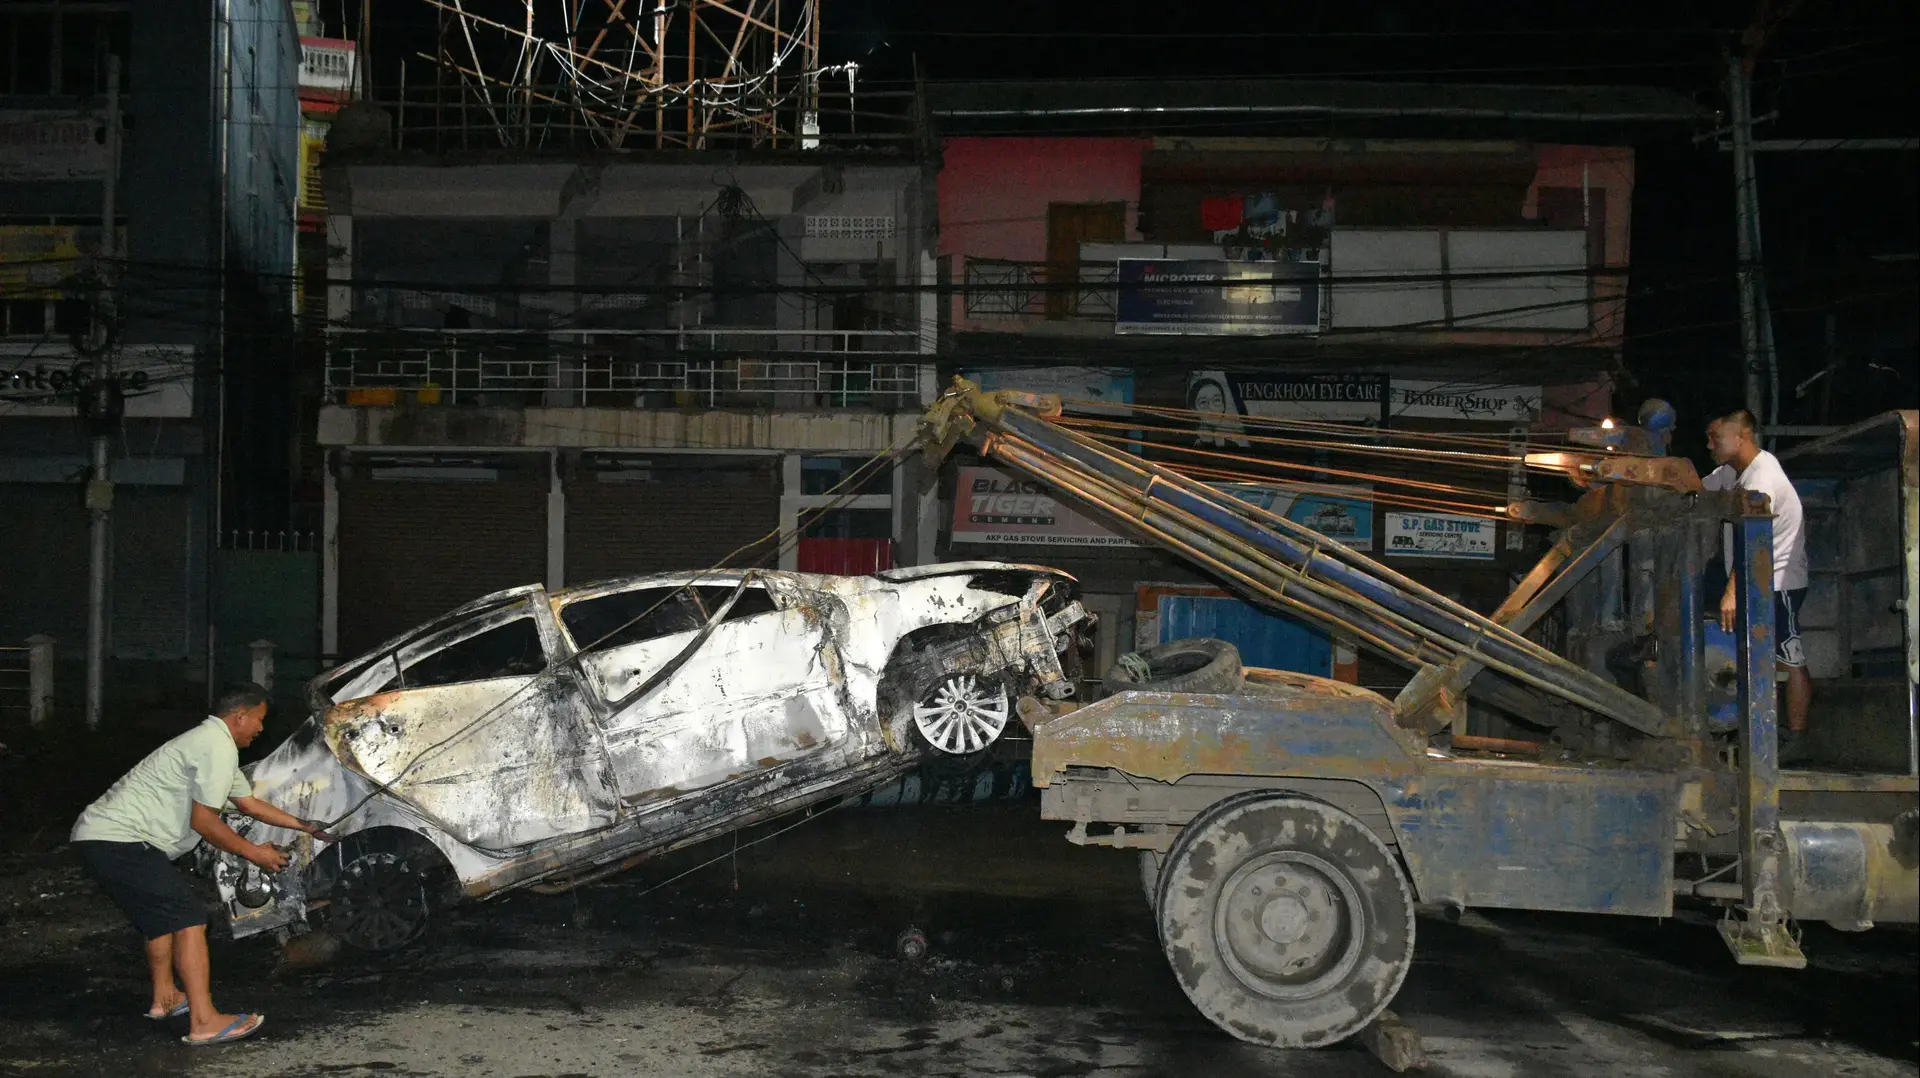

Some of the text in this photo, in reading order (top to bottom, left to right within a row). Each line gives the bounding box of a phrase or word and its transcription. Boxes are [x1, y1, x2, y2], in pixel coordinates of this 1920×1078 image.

[1237, 382, 1382, 400] YENGKHOM EYE CARE
[970, 495, 1056, 515] TIGER
[971, 515, 1053, 525] CEMENT
[1424, 519, 1445, 531] GAS
[1447, 520, 1481, 533] STOVE
[985, 534, 1001, 542] AKP
[1003, 534, 1019, 543] GAS
[1020, 535, 1046, 543] STOVE
[1047, 535, 1088, 544] SERVICING
[1090, 537, 1107, 545] AND
[1108, 537, 1128, 546] PART
